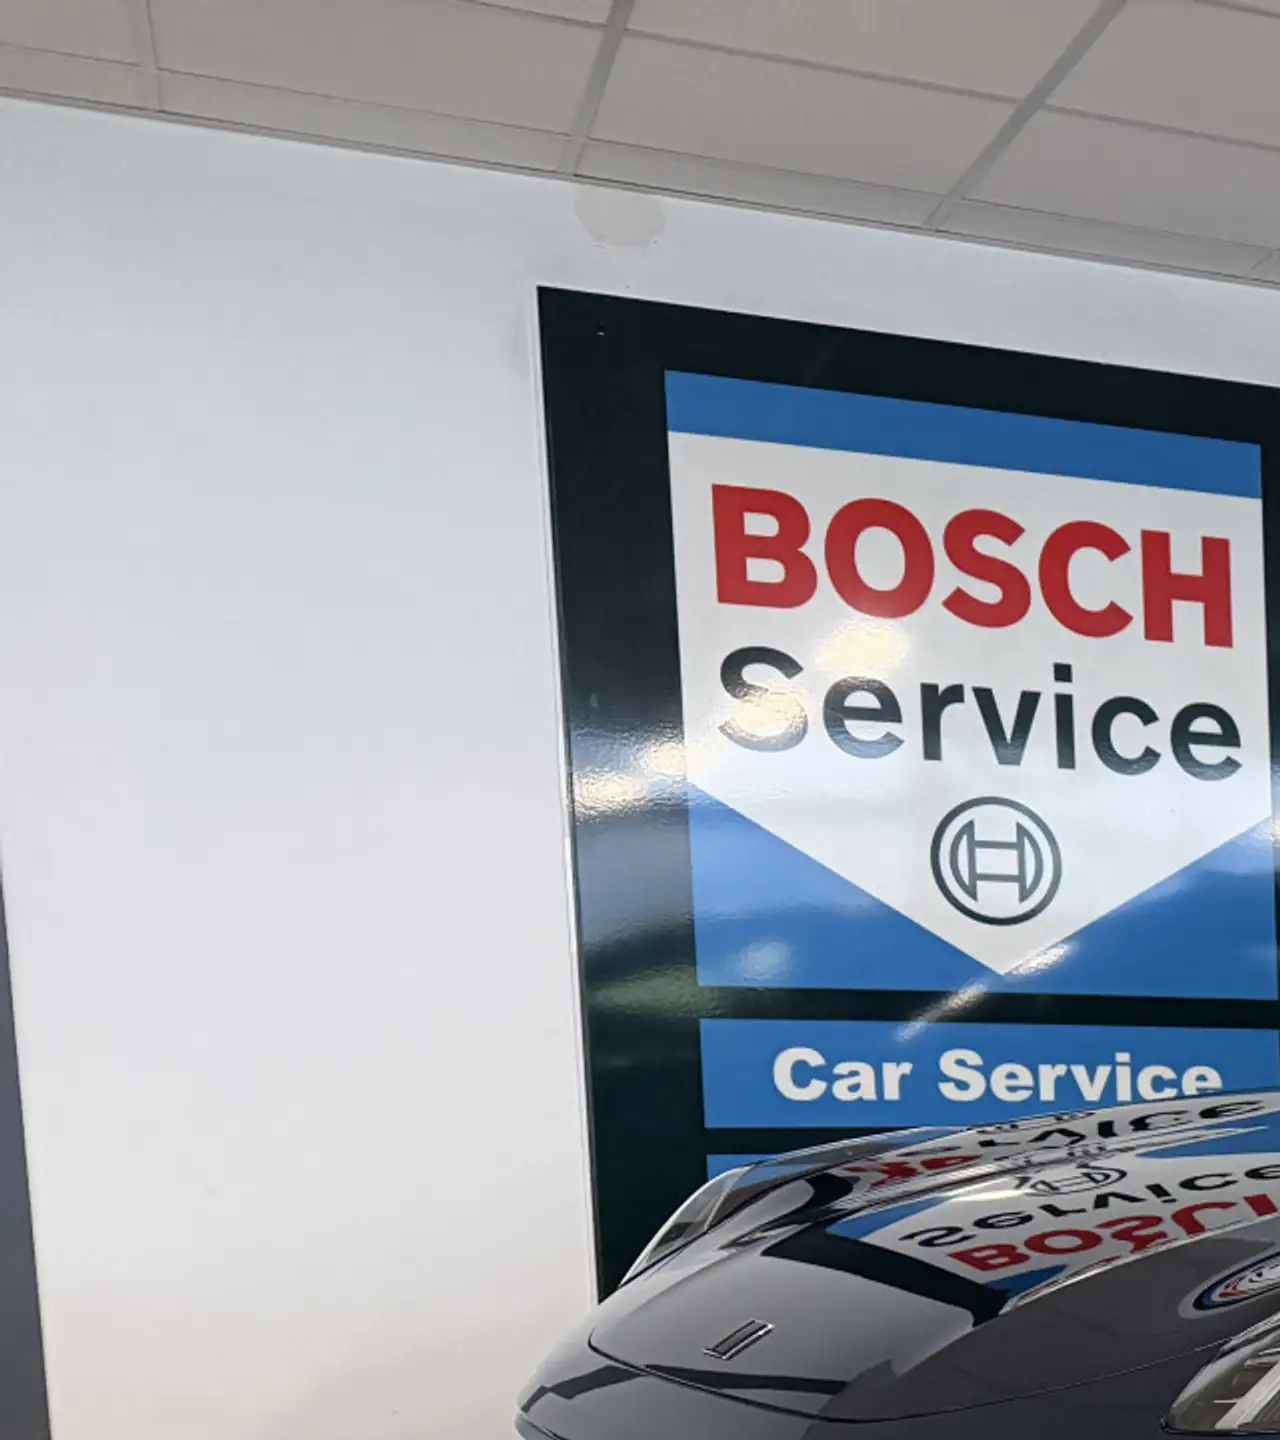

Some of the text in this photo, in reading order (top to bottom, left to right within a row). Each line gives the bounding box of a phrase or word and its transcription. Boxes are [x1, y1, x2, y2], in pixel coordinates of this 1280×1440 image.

[711, 483, 1234, 648] BOSCH
[719, 645, 1242, 782] Service
[773, 1047, 1223, 1102] Car Service
